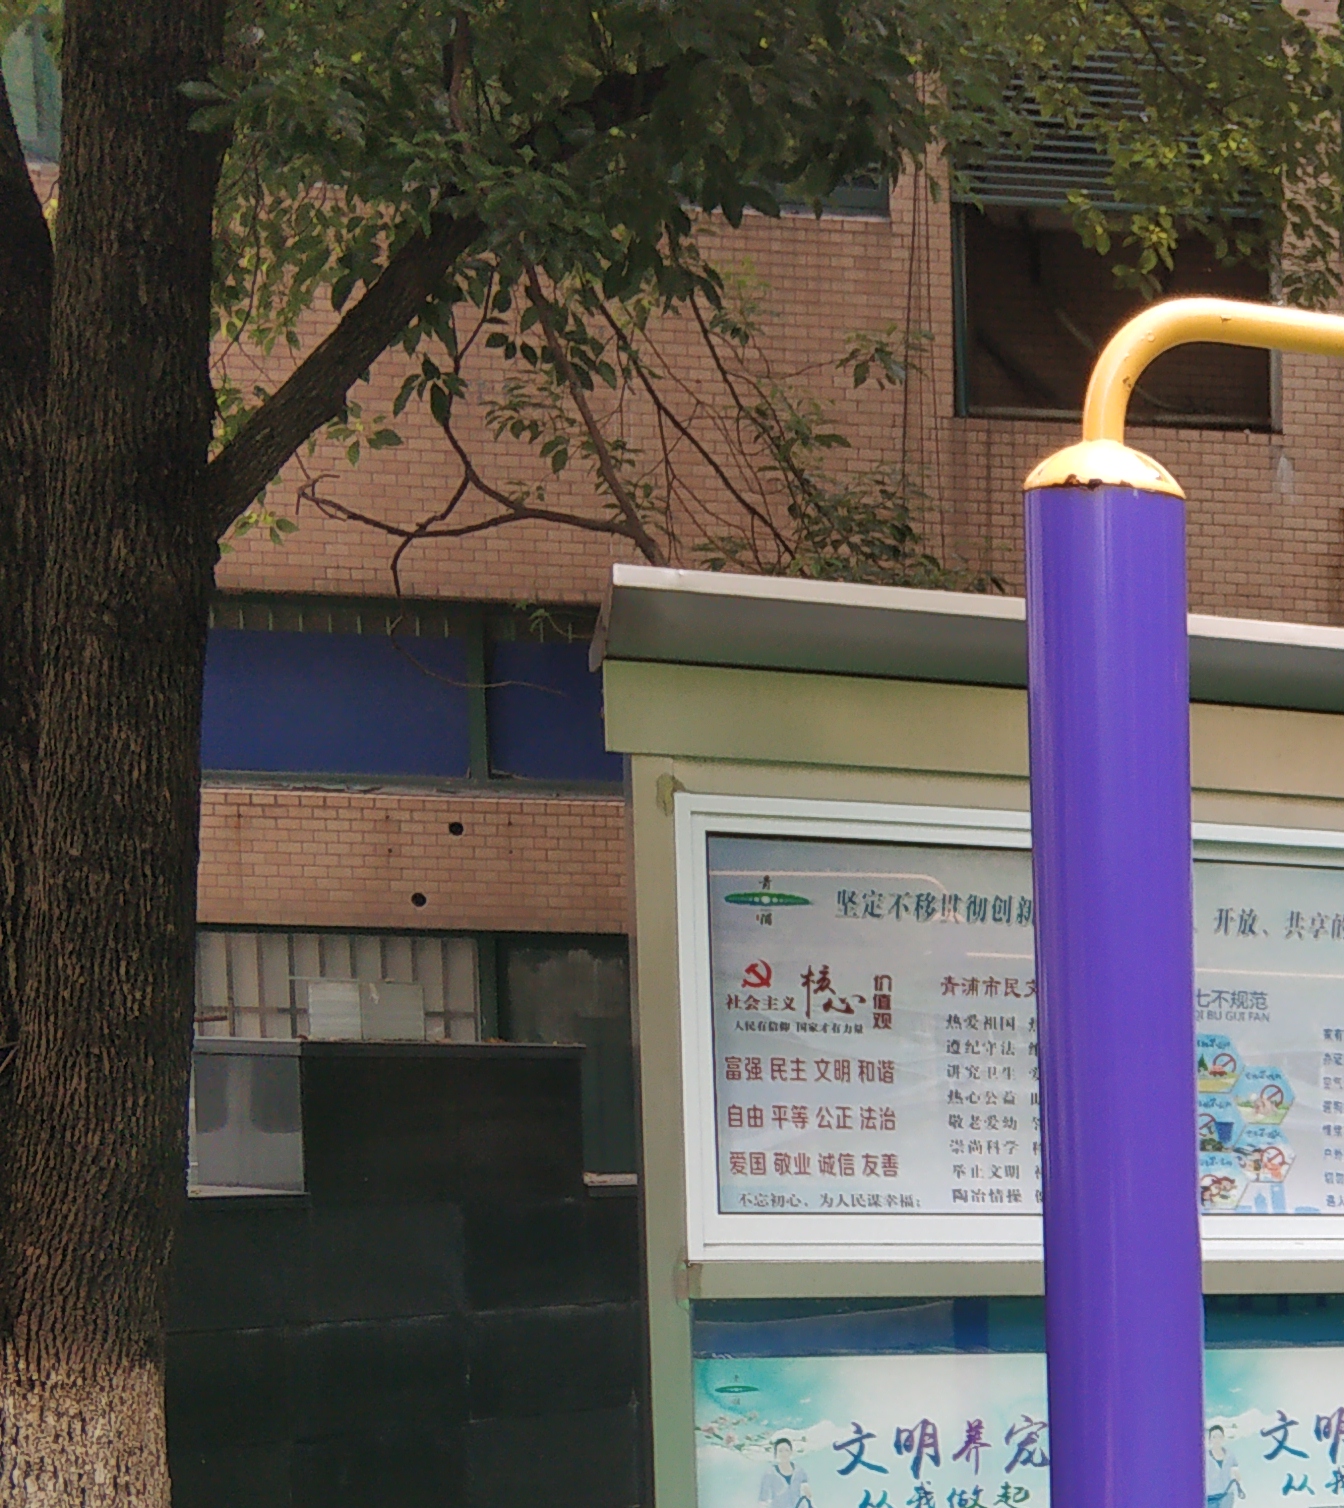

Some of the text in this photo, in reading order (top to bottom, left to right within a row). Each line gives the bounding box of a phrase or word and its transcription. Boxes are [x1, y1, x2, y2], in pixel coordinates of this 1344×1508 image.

[726, 964, 893, 1030] 社会主义 核心 价值观
[946, 1013, 1016, 1031] 热爱祖国
[1248, 1012, 1271, 1023] FAN
[734, 1020, 865, 1035] 人民有信仰 国家才有力量
[946, 1038, 1016, 1056] 遵纪守法
[724, 1056, 896, 1084] 富强 民主 文明 和谐
[946, 1064, 1016, 1080] 讲究卫生
[947, 1089, 1017, 1106] 热心公益
[727, 1104, 897, 1131] 自由 平等 公正 法治
[948, 1113, 1018, 1131] 敬老爱幼
[949, 1139, 1019, 1155] 崇尚科学
[729, 1151, 900, 1178] 爱国 敬业 诚信 友善
[952, 1164, 1020, 1180] 举止文明
[952, 1188, 1022, 1204] 陶冶情操
[832, 1414, 1050, 1480] 文明养宠
